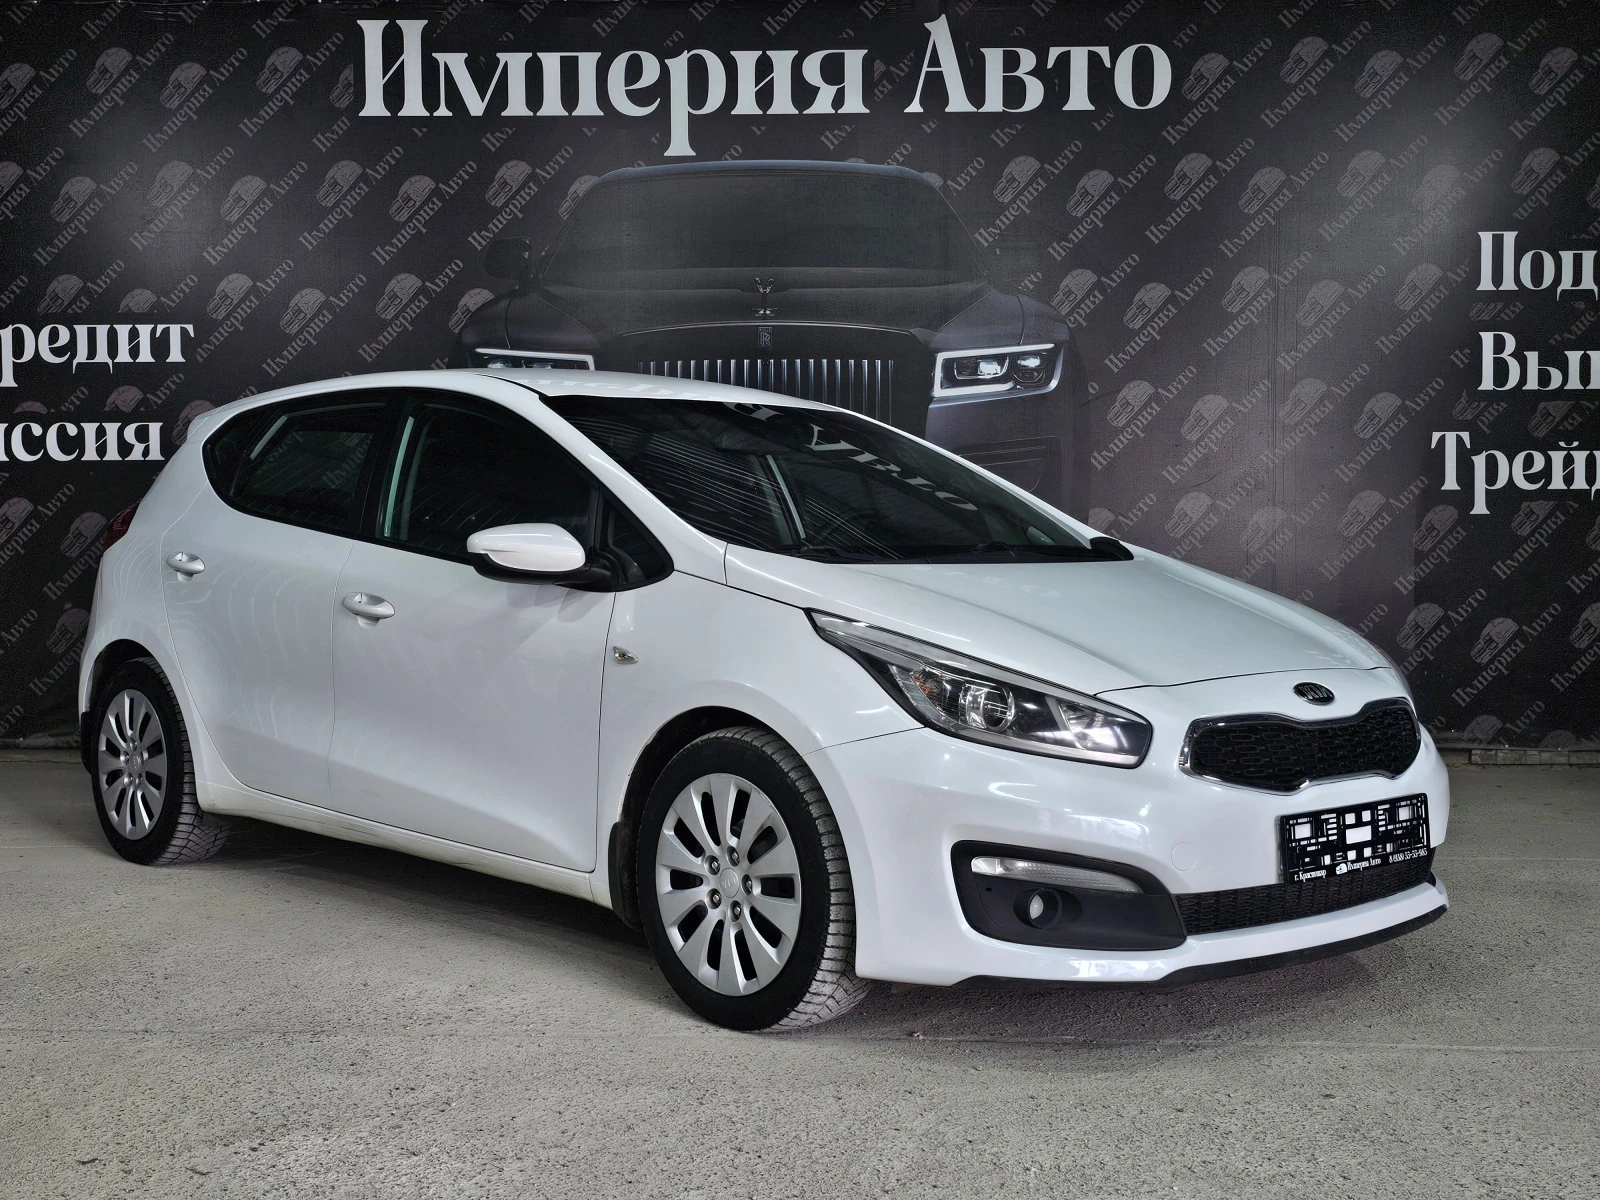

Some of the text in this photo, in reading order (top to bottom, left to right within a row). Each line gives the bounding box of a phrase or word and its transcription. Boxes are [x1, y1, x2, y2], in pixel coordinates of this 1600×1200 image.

[39, 49, 78, 87] Авто
[68, 33, 174, 138] Империя Авто
[142, 84, 214, 153] Империя
[209, 48, 248, 86] Авто
[238, 68, 310, 137] Империя
[305, 32, 344, 70] Авто
[357, 14, 1172, 156] Империя Авто
[1162, 37, 1272, 146] Империя Авто
[1260, 58, 1335, 130] Империя
[1330, 21, 1370, 60] Авто
[1335, 34, 1445, 143] Империя Авто
[1508, 68, 1585, 140] Империя
[26, 147, 65, 185] Авто
[32, 198, 104, 267] Империя
[99, 162, 138, 200] Авто
[202, 161, 308, 266] Империя Авто
[298, 182, 370, 251] Империя
[365, 146, 404, 184] Авто
[371, 161, 477, 266] Империя Авто
[467, 182, 539, 251] Империя
[534, 146, 573, 184] Авто
[945, 157, 985, 196] Авто
[974, 178, 1047, 248] Империя
[1042, 141, 1082, 180] Авто
[1047, 153, 1157, 262] Империя Авто
[1145, 137, 1255, 246] Империя Авто
[1219, 151, 1329, 260] Империя Авто
[86, 259, 125, 297] Авто
[256, 259, 295, 297] Авто
[358, 259, 464, 364] Империя Авто
[1066, 252, 1141, 329] ерия Авто
[1202, 250, 1312, 359] Империя Авто
[1276, 264, 1386, 373] Империя Авто
[1475, 231, 1598, 301] Под
[261, 309, 333, 378] Империя
[328, 273, 367, 311] Авто
[1104, 266, 1214, 375] Империя Авто
[1375, 285, 1450, 357] Империя
[1477, 331, 1600, 391] Вып
[61, 386, 89, 412] вто
[147, 371, 186, 409] Авто
[1087, 364, 1197, 473] Империя Авто
[1161, 378, 1271, 487] Империя Авто
[1334, 376, 1444, 485] Империя Авто
[40, 482, 79, 520] Авто
[1118, 491, 1159, 531] Авто
[1430, 431, 1600, 514] Трей
[1318, 474, 1428, 583] Империя Авто
[1392, 525, 1467, 597] Империя
[1490, 510, 1565, 582] Империя
[1447, 586, 1487, 625] Авто
[1451, 601, 1561, 710] Империя Авто
[1298, 685, 1333, 700] KIA
